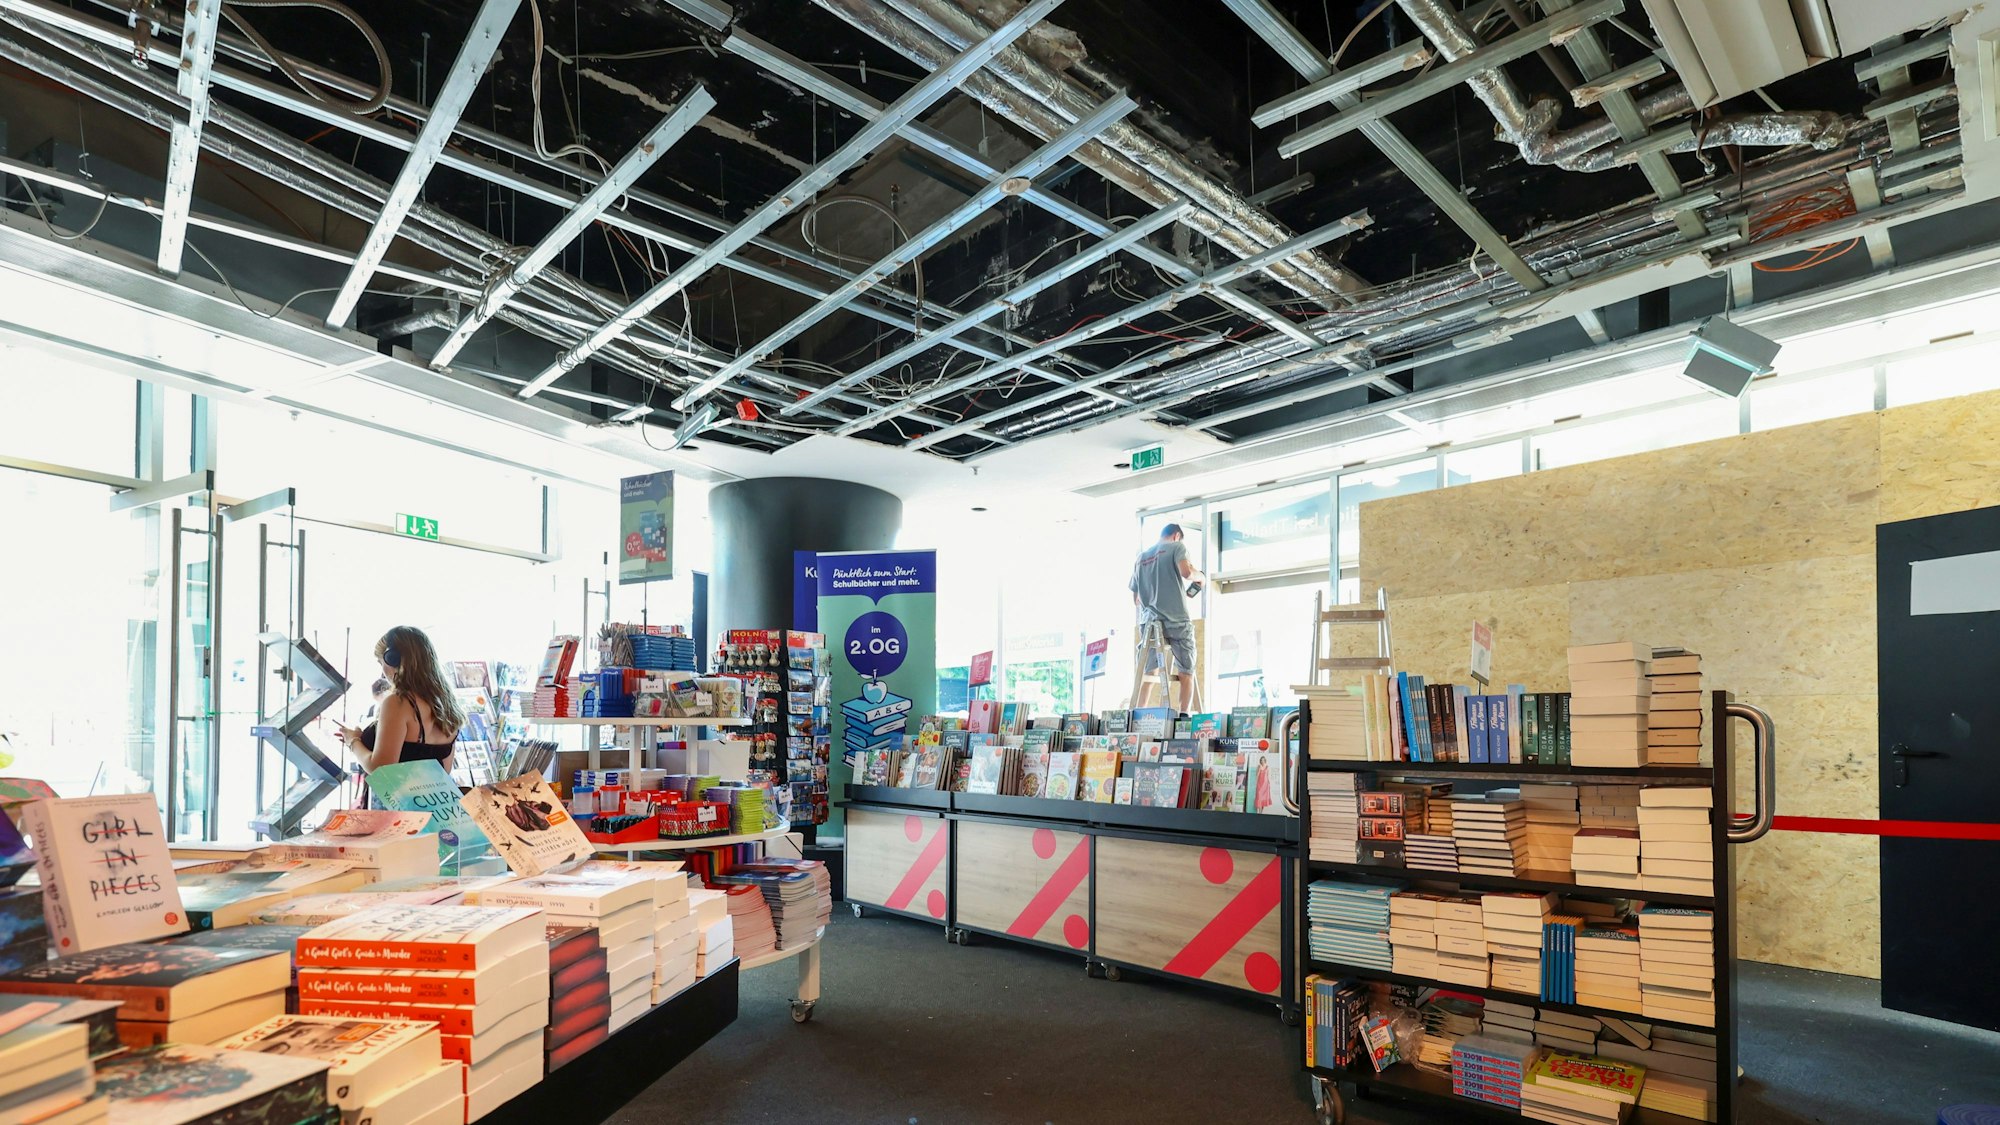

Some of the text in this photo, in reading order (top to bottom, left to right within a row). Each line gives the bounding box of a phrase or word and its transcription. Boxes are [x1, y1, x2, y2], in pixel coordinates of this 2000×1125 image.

[833, 567, 872, 578] Pünktlich
[894, 566, 917, 576] Start:
[833, 578, 920, 588] Schulbücher und mehr.
[871, 626, 881, 634] im
[850, 638, 900, 655] 2. OG
[1194, 731, 1218, 739] YOGA
[413, 790, 461, 808] CULPA
[83, 816, 153, 843] GIRL
[544, 836, 561, 846] REICH
[105, 848, 138, 868] IN
[89, 874, 161, 901] PIECES
[311, 947, 329, 957] Good
[331, 947, 352, 958] Girl's
[355, 948, 375, 958] Guide
[382, 948, 411, 959] Murder
[313, 981, 331, 992] Good
[333, 981, 354, 992] Girl's
[356, 982, 377, 993] Guide
[384, 982, 412, 993] Murder
[1306, 981, 1312, 991] 18
[242, 1018, 293, 1042] OF US
[351, 1022, 412, 1055] LYING
[1464, 1052, 1483, 1061] BLOCK
[1464, 1062, 1483, 1072] BLOCK
[1550, 1059, 1637, 1081] JUMBO
[1464, 1072, 1483, 1081] BLOCK
[1549, 1065, 1634, 1089] RÄTSEL
[1464, 1081, 1483, 1090] BLOCK
[1464, 1089, 1483, 1099] BLOCK
